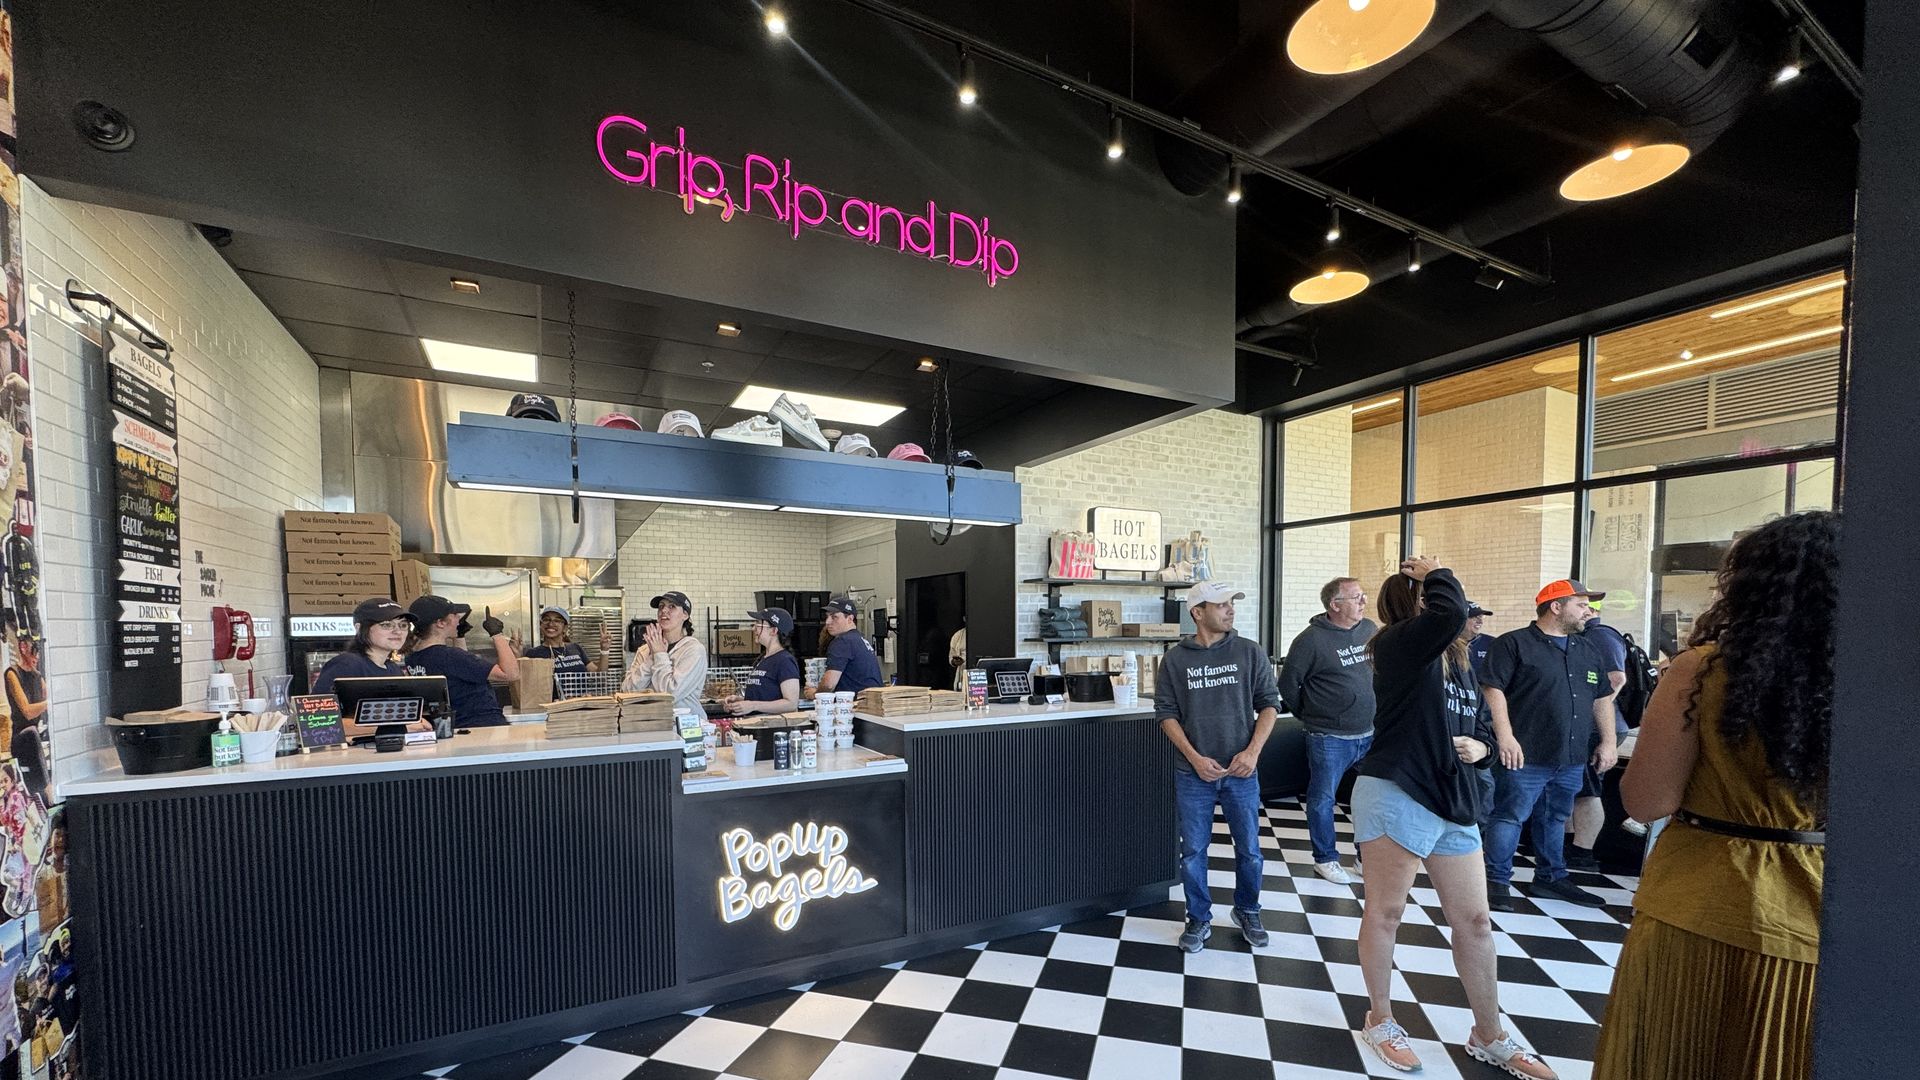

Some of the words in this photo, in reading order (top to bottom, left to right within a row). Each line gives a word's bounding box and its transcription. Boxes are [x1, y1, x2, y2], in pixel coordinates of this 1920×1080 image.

[597, 114, 733, 222] Grip,
[744, 153, 828, 239] Rip
[840, 200, 936, 260] and
[949, 211, 1019, 288] Dip
[130, 347, 162, 379] BAGELS
[124, 418, 156, 445] SCHMEAR
[153, 501, 177, 525] butter
[120, 514, 144, 538] GARLIC
[1113, 519, 1145, 538] HOT
[1619, 513, 1636, 552] BASE
[302, 537, 313, 545] Not
[122, 550, 137, 559] EXTRA
[1100, 541, 1157, 561] BAGELS
[144, 566, 163, 582] FISH
[139, 605, 169, 619] DRINKS
[292, 621, 337, 632] DRINKS
[1336, 647, 1350, 658] Not
[1349, 644, 1367, 655] fam
[1340, 656, 1354, 667] but
[1186, 666, 1202, 679] Not
[1203, 662, 1238, 677] famous
[1187, 677, 1204, 690] but
[1204, 674, 1238, 689] known.
[214, 752, 226, 760] but
[215, 745, 225, 754] Not
[226, 744, 240, 753] fam
[719, 854, 879, 932] Bagels
